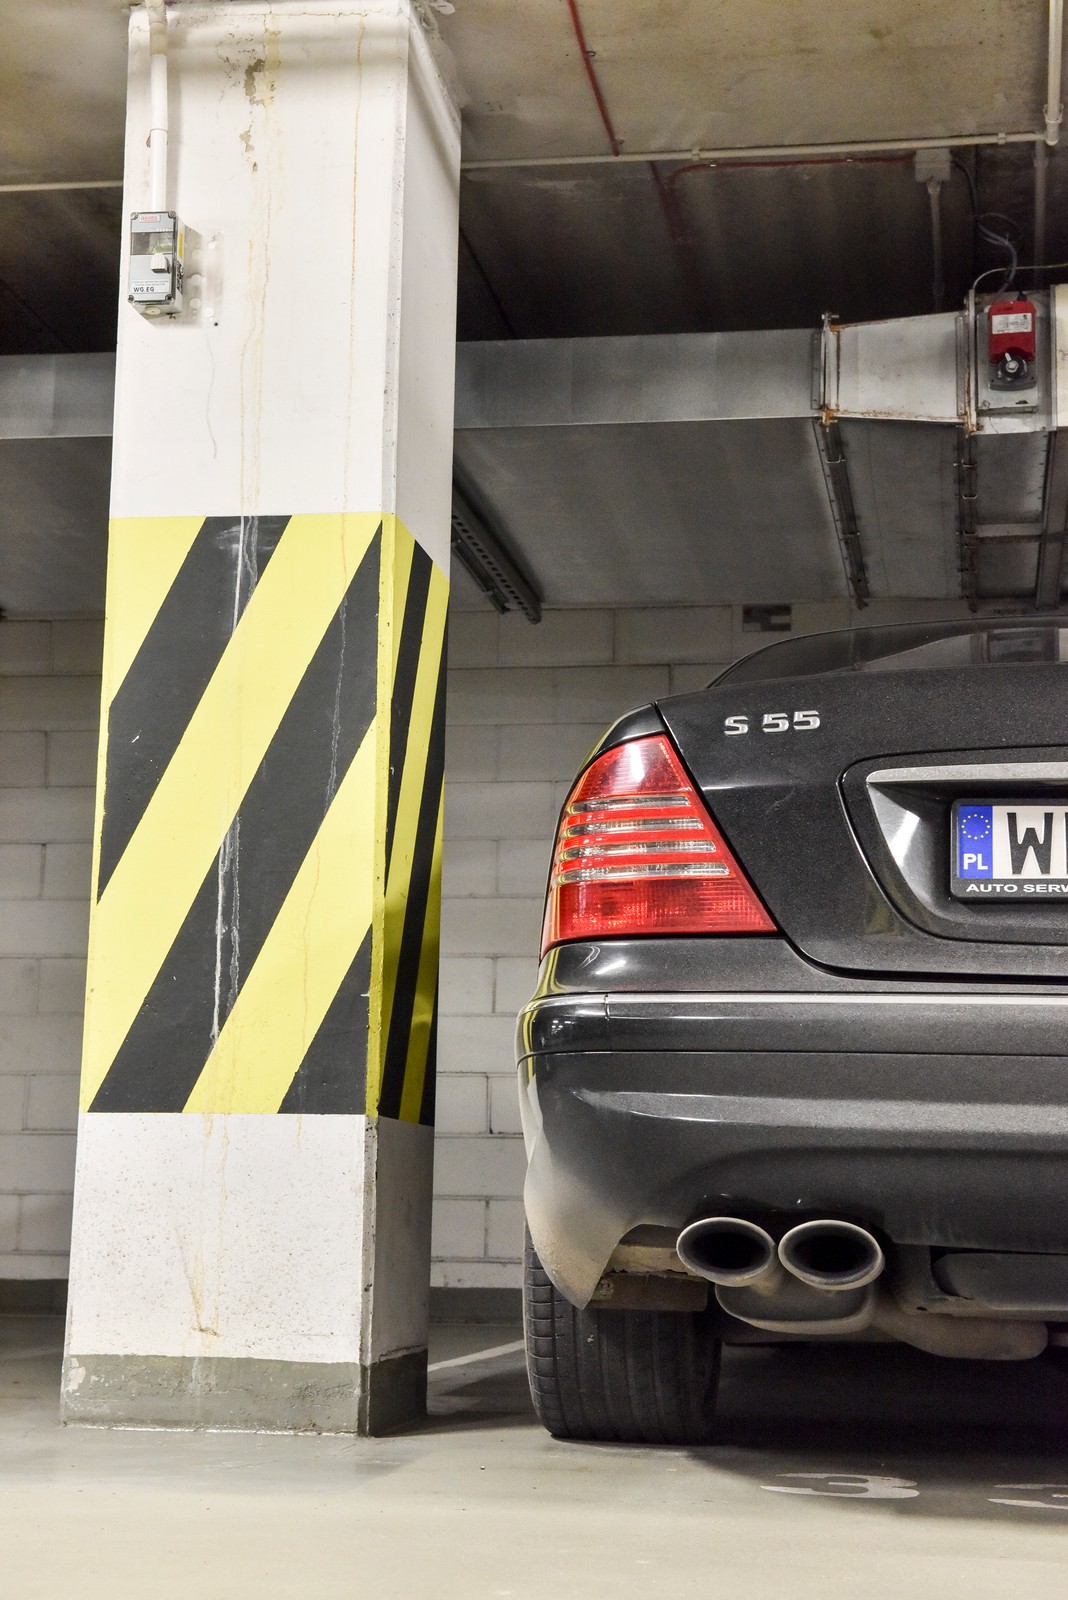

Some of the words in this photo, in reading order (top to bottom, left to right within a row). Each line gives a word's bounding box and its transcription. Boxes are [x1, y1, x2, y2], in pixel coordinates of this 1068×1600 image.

[724, 715, 749, 735] S
[762, 710, 821, 733] 55
[1007, 812, 1068, 874] W
[963, 853, 988, 870] PL
[966, 884, 1018, 892] AUTO
